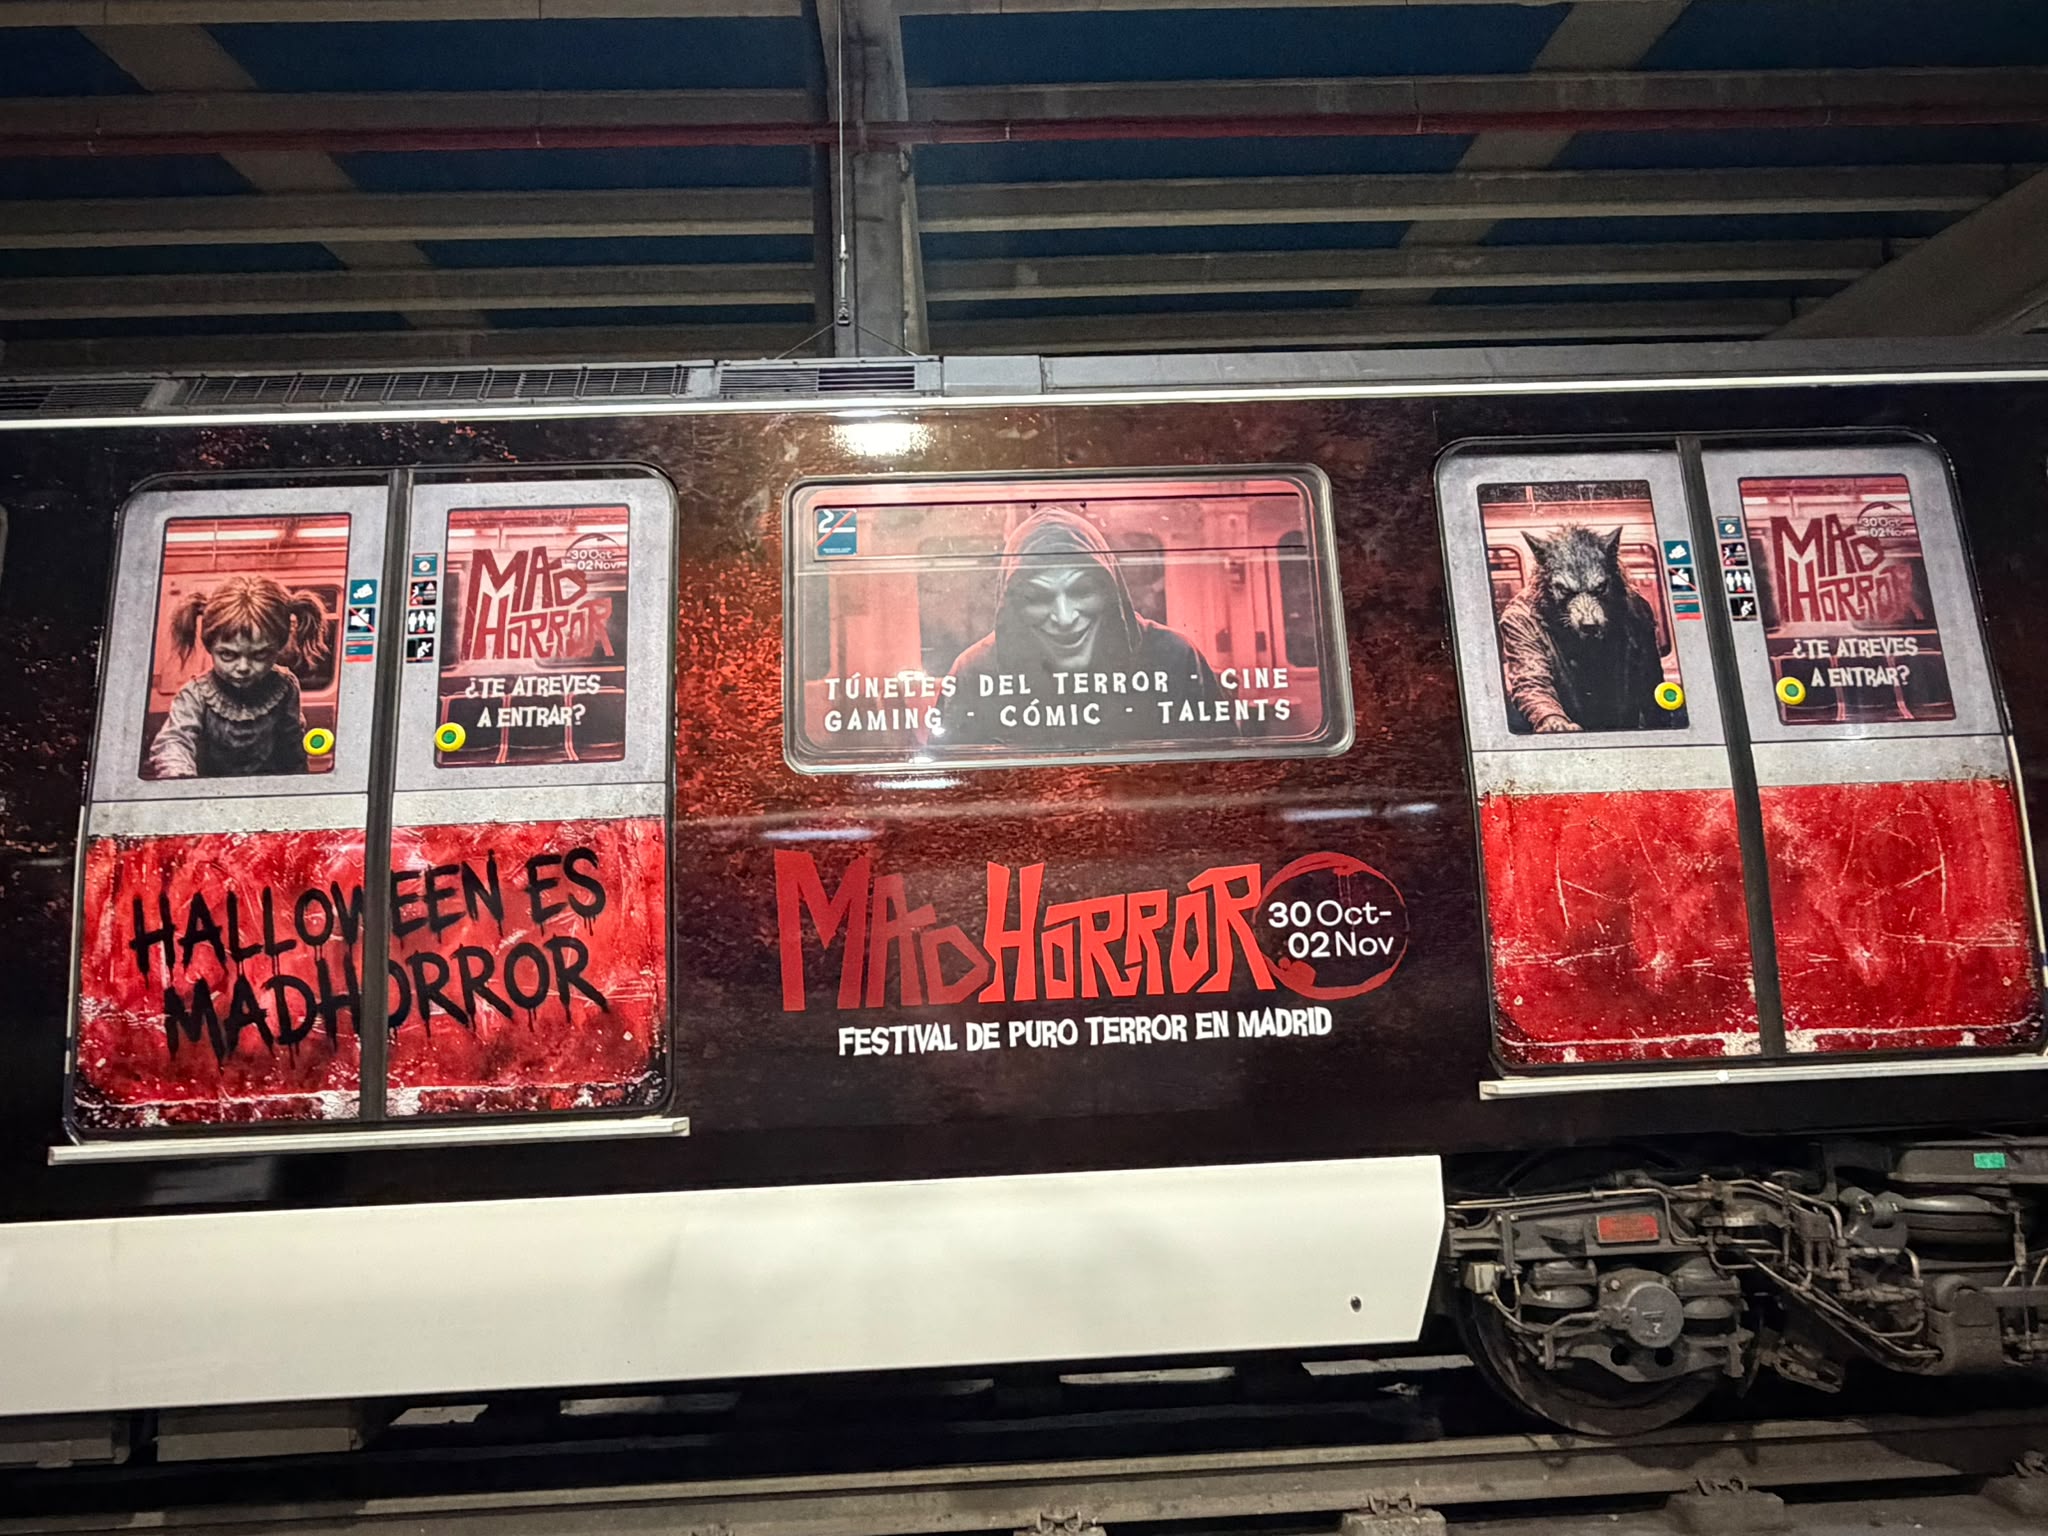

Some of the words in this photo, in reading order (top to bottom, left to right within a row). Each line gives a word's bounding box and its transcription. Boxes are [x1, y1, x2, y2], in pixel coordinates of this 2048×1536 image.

[577, 560, 593, 570] 02
[1770, 514, 1885, 622] MAD
[460, 546, 588, 661] MAD
[1788, 556, 1925, 623] HORROR
[472, 592, 615, 660] HORROR
[1793, 638, 1831, 659] ¿TE
[1836, 637, 1919, 659] ATREVES
[465, 677, 506, 698] ¿TE
[511, 674, 602, 698] ATREVES
[825, 672, 957, 700] TÚNELES
[979, 674, 1031, 697] DEL
[1053, 670, 1168, 694] TERROR
[1220, 667, 1289, 690] CINE
[1811, 666, 1825, 687] A
[1827, 664, 1911, 687] ENTRAR?
[476, 706, 492, 728] A
[496, 703, 587, 728] ENTRAR?
[824, 706, 943, 732] GAMING
[1000, 698, 1101, 727] CÓMIC
[1157, 698, 1291, 724] TALENTS
[129, 849, 504, 980] HALLOWEEN
[525, 847, 606, 932] ES
[1267, 901, 1311, 928] 30
[1288, 932, 1331, 958] 02
[1335, 931, 1395, 957] Nov
[838, 1022, 958, 1057] FESTIVAL
[966, 1021, 1000, 1051] DE
[1009, 1018, 1078, 1048] PURO
[1085, 1013, 1188, 1046] TERROR
[1195, 1010, 1229, 1040] EN
[1237, 1006, 1332, 1039] MADRID
